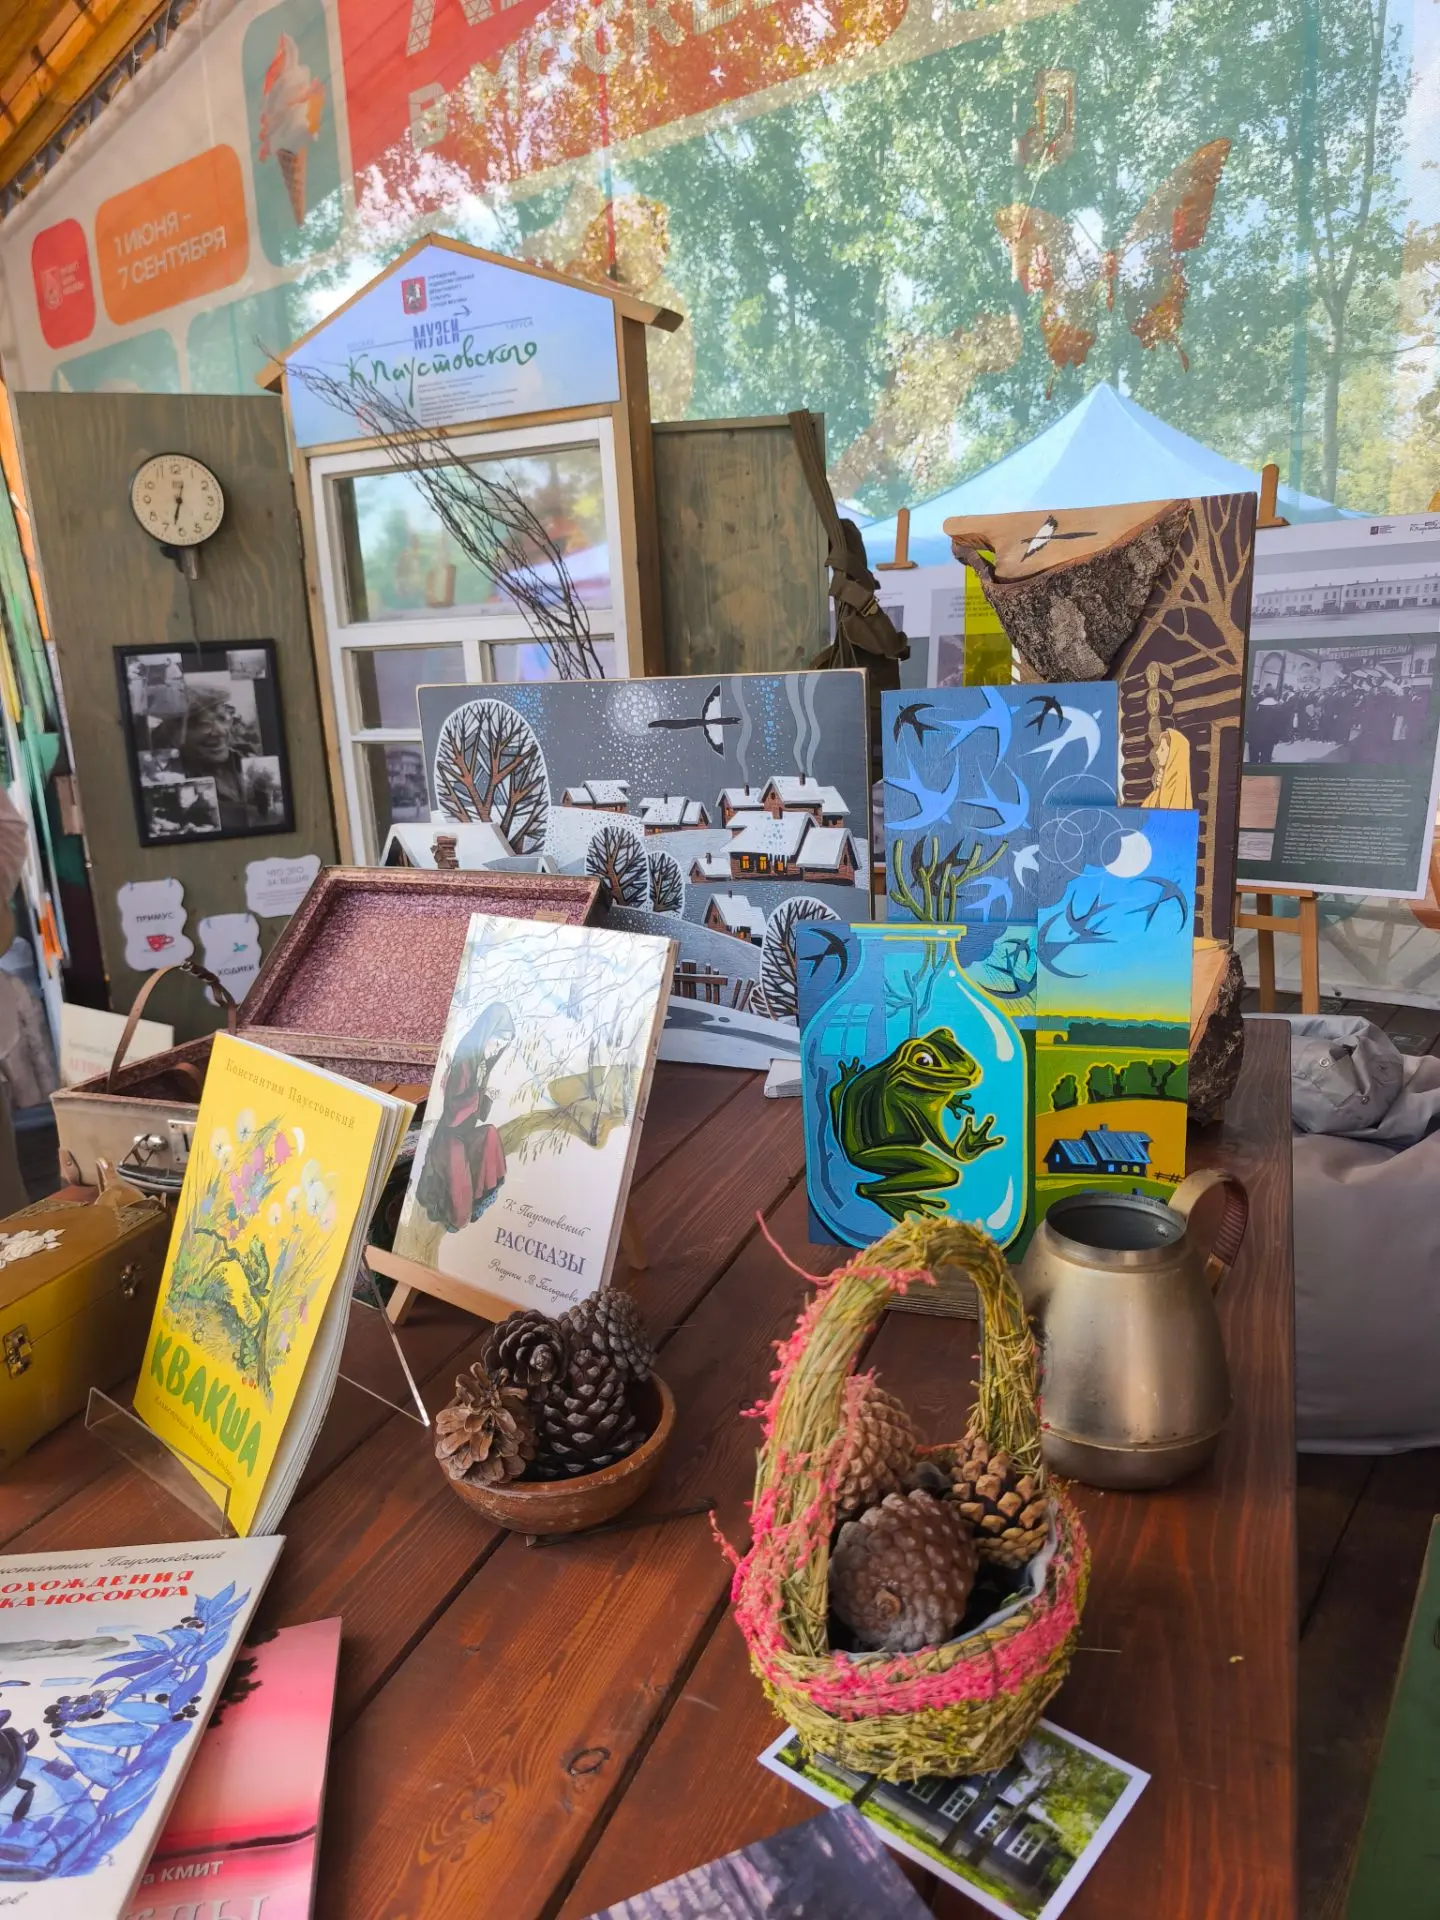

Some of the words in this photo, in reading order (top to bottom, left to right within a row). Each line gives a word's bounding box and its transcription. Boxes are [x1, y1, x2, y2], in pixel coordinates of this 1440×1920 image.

[113, 236, 124, 259] 1
[124, 210, 180, 255] ИЮНЯ
[117, 265, 129, 291] 7
[131, 225, 228, 285] СЕНТЯБРЯ
[136, 912, 175, 924] ПРИМУС
[217, 964, 256, 977] ХОДИКИ
[226, 1058, 285, 1096] Константин
[288, 1086, 356, 1129] Паустовский
[517, 1203, 592, 1237] Паустовский
[494, 1226, 586, 1276] РАССКАЗЫ
[487, 1258, 522, 1282] Рисунки
[150, 1330, 262, 1478] КВАКША
[100, 1550, 227, 1571] Паустовский
[1, 1570, 194, 1594] ОХОЖДЕНИЯ
[160, 1860, 224, 1883] КМИТ
